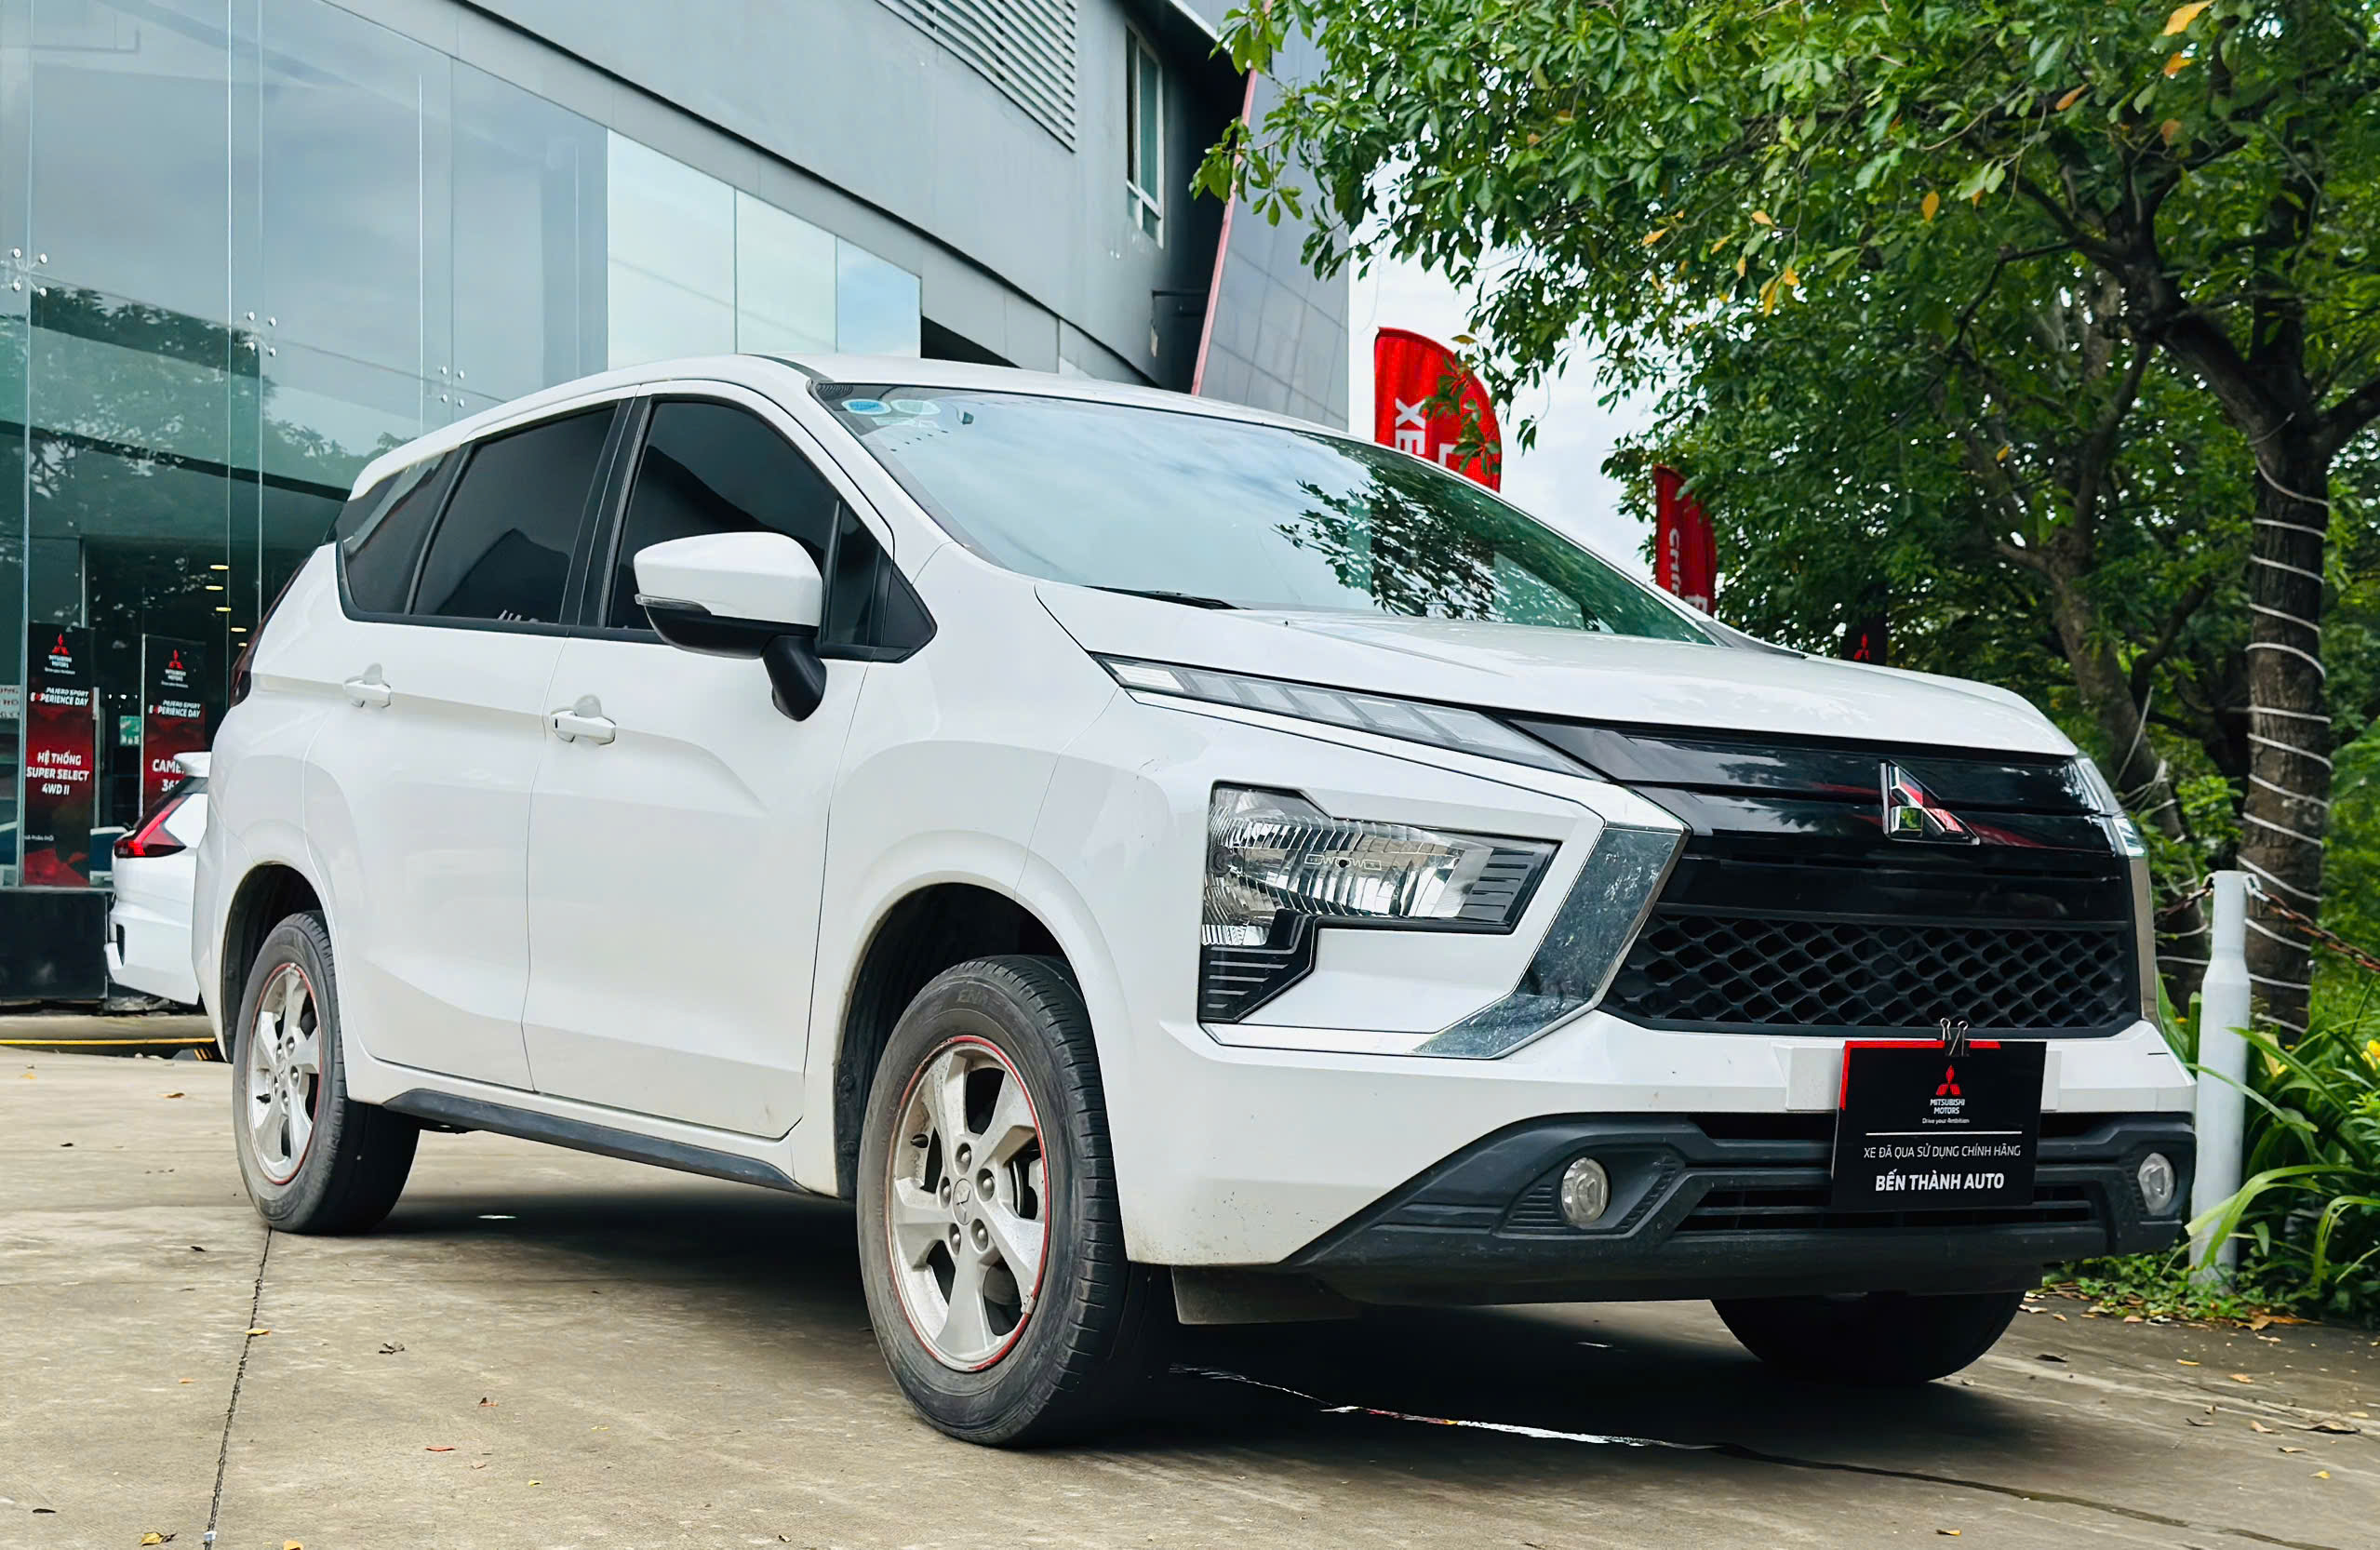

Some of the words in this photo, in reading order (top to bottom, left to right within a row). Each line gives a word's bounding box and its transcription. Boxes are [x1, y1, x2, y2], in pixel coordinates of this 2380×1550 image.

[30, 691, 74, 706] EXPERIENCE
[74, 696, 89, 707] DAY
[149, 704, 187, 716] EXPERIENCE
[188, 707, 201, 718] DAY
[37, 749, 50, 766] HỆ
[51, 749, 82, 766] THỐNG
[153, 758, 184, 774] CAME
[26, 767, 56, 779] SUPER
[57, 768, 90, 782] SELECT
[41, 782, 62, 795] 4WD
[63, 784, 70, 795] II
[1930, 1098, 1965, 1106] MITSUBISHI
[1933, 1106, 1959, 1115] MOTORS
[1864, 1147, 1876, 1158] XE
[1879, 1144, 1892, 1158] ĐÃ
[1894, 1146, 1915, 1159] QUA
[1917, 1142, 1931, 1157] SỬ
[1932, 1145, 1959, 1159] DỤNG
[1961, 1142, 1992, 1157] CHÍNH
[1993, 1143, 2021, 1156] HÃNG
[1875, 1169, 1905, 1191] BẾN
[1909, 1169, 1961, 1191] THÀNH
[1963, 1173, 2004, 1190] AUTO
